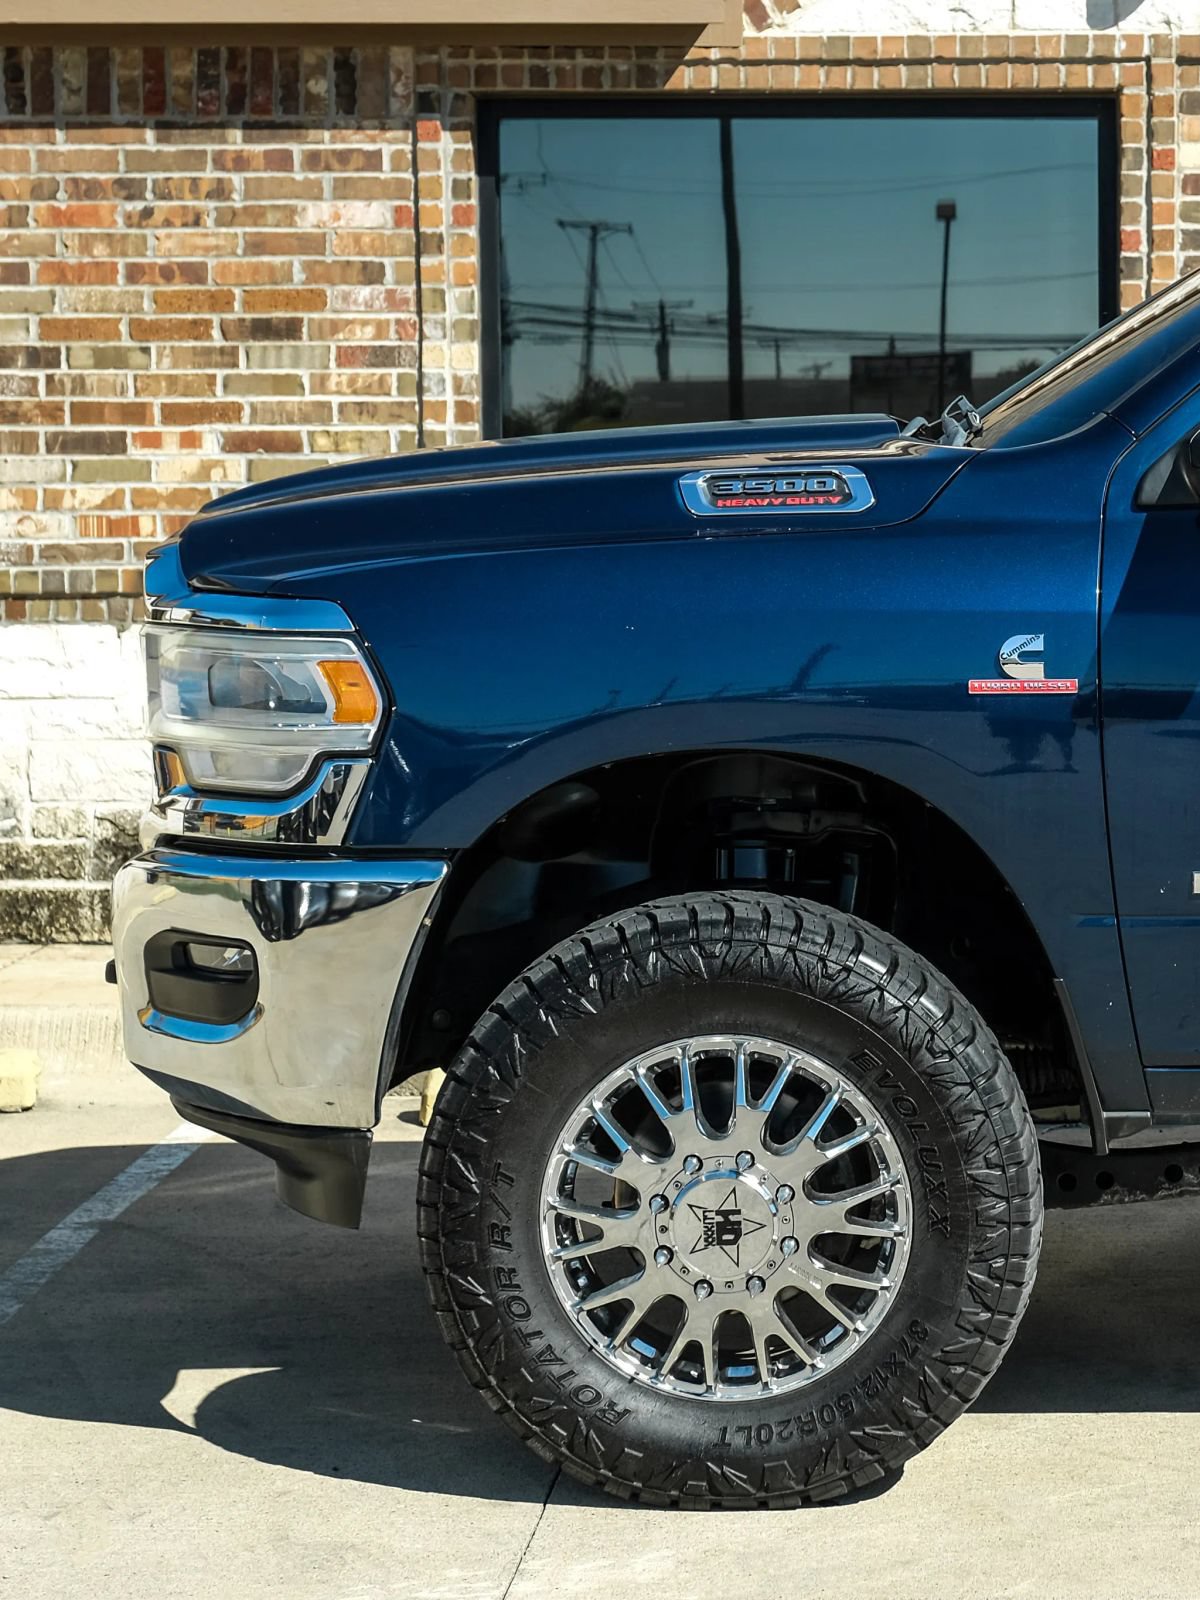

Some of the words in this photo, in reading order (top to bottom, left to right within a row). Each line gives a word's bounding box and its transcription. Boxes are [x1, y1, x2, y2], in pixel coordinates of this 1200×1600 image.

[713, 477, 836, 494] 3500
[717, 497, 783, 507] HEAVY
[786, 496, 842, 505] DUTY
[1000, 635, 1041, 660] Cummins
[972, 681, 1021, 691] TURBO
[1024, 681, 1076, 691] DIESEL
[849, 1049, 951, 1238] EVOLUXX
[488, 1160, 515, 1251] R/T
[715, 1209, 742, 1246] HD
[493, 1264, 631, 1427] ROTATOR
